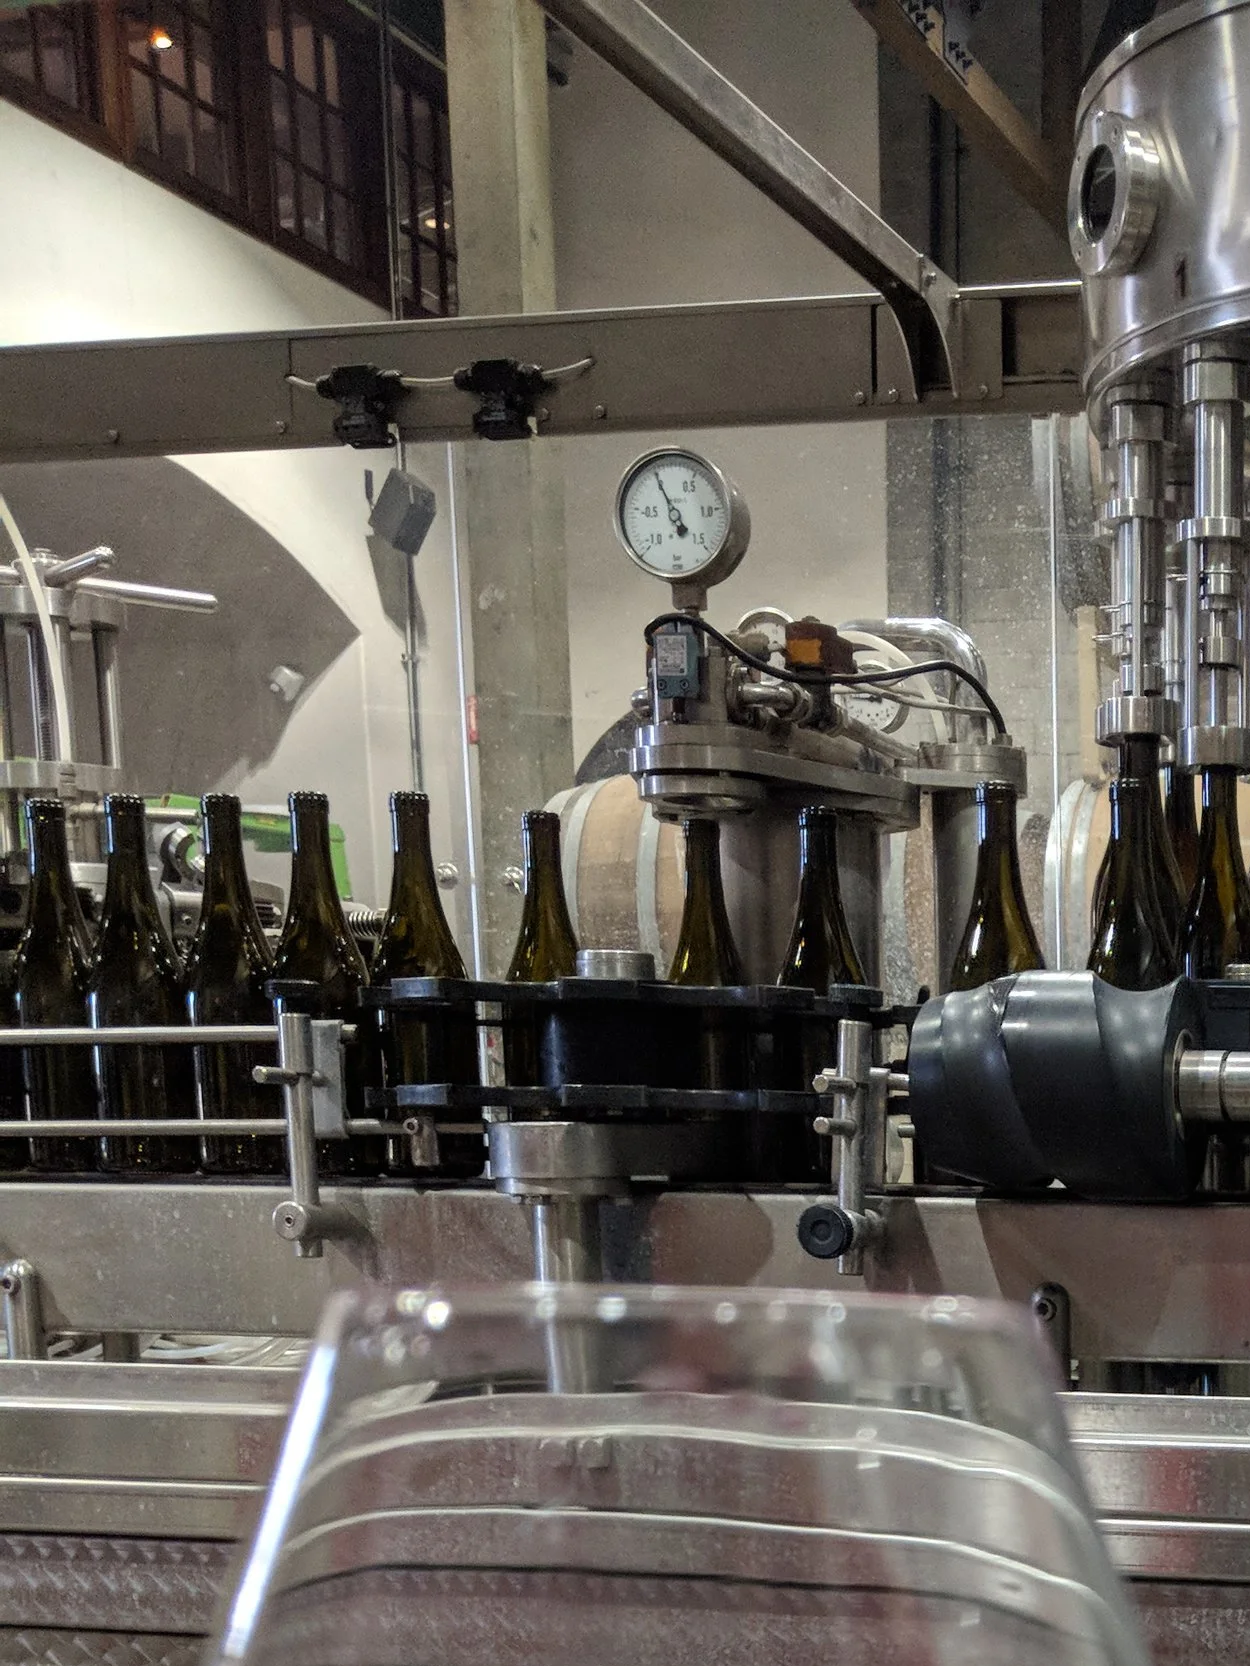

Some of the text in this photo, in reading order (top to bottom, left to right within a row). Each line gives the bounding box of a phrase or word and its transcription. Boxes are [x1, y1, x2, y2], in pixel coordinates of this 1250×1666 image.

[1174, 257, 1187, 299] 1
[682, 480, 696, 493] 0.5
[641, 505, 659, 518] -0.5
[700, 505, 714, 518] 1.0
[644, 533, 663, 545] -1.0
[692, 532, 705, 545] 1.5
